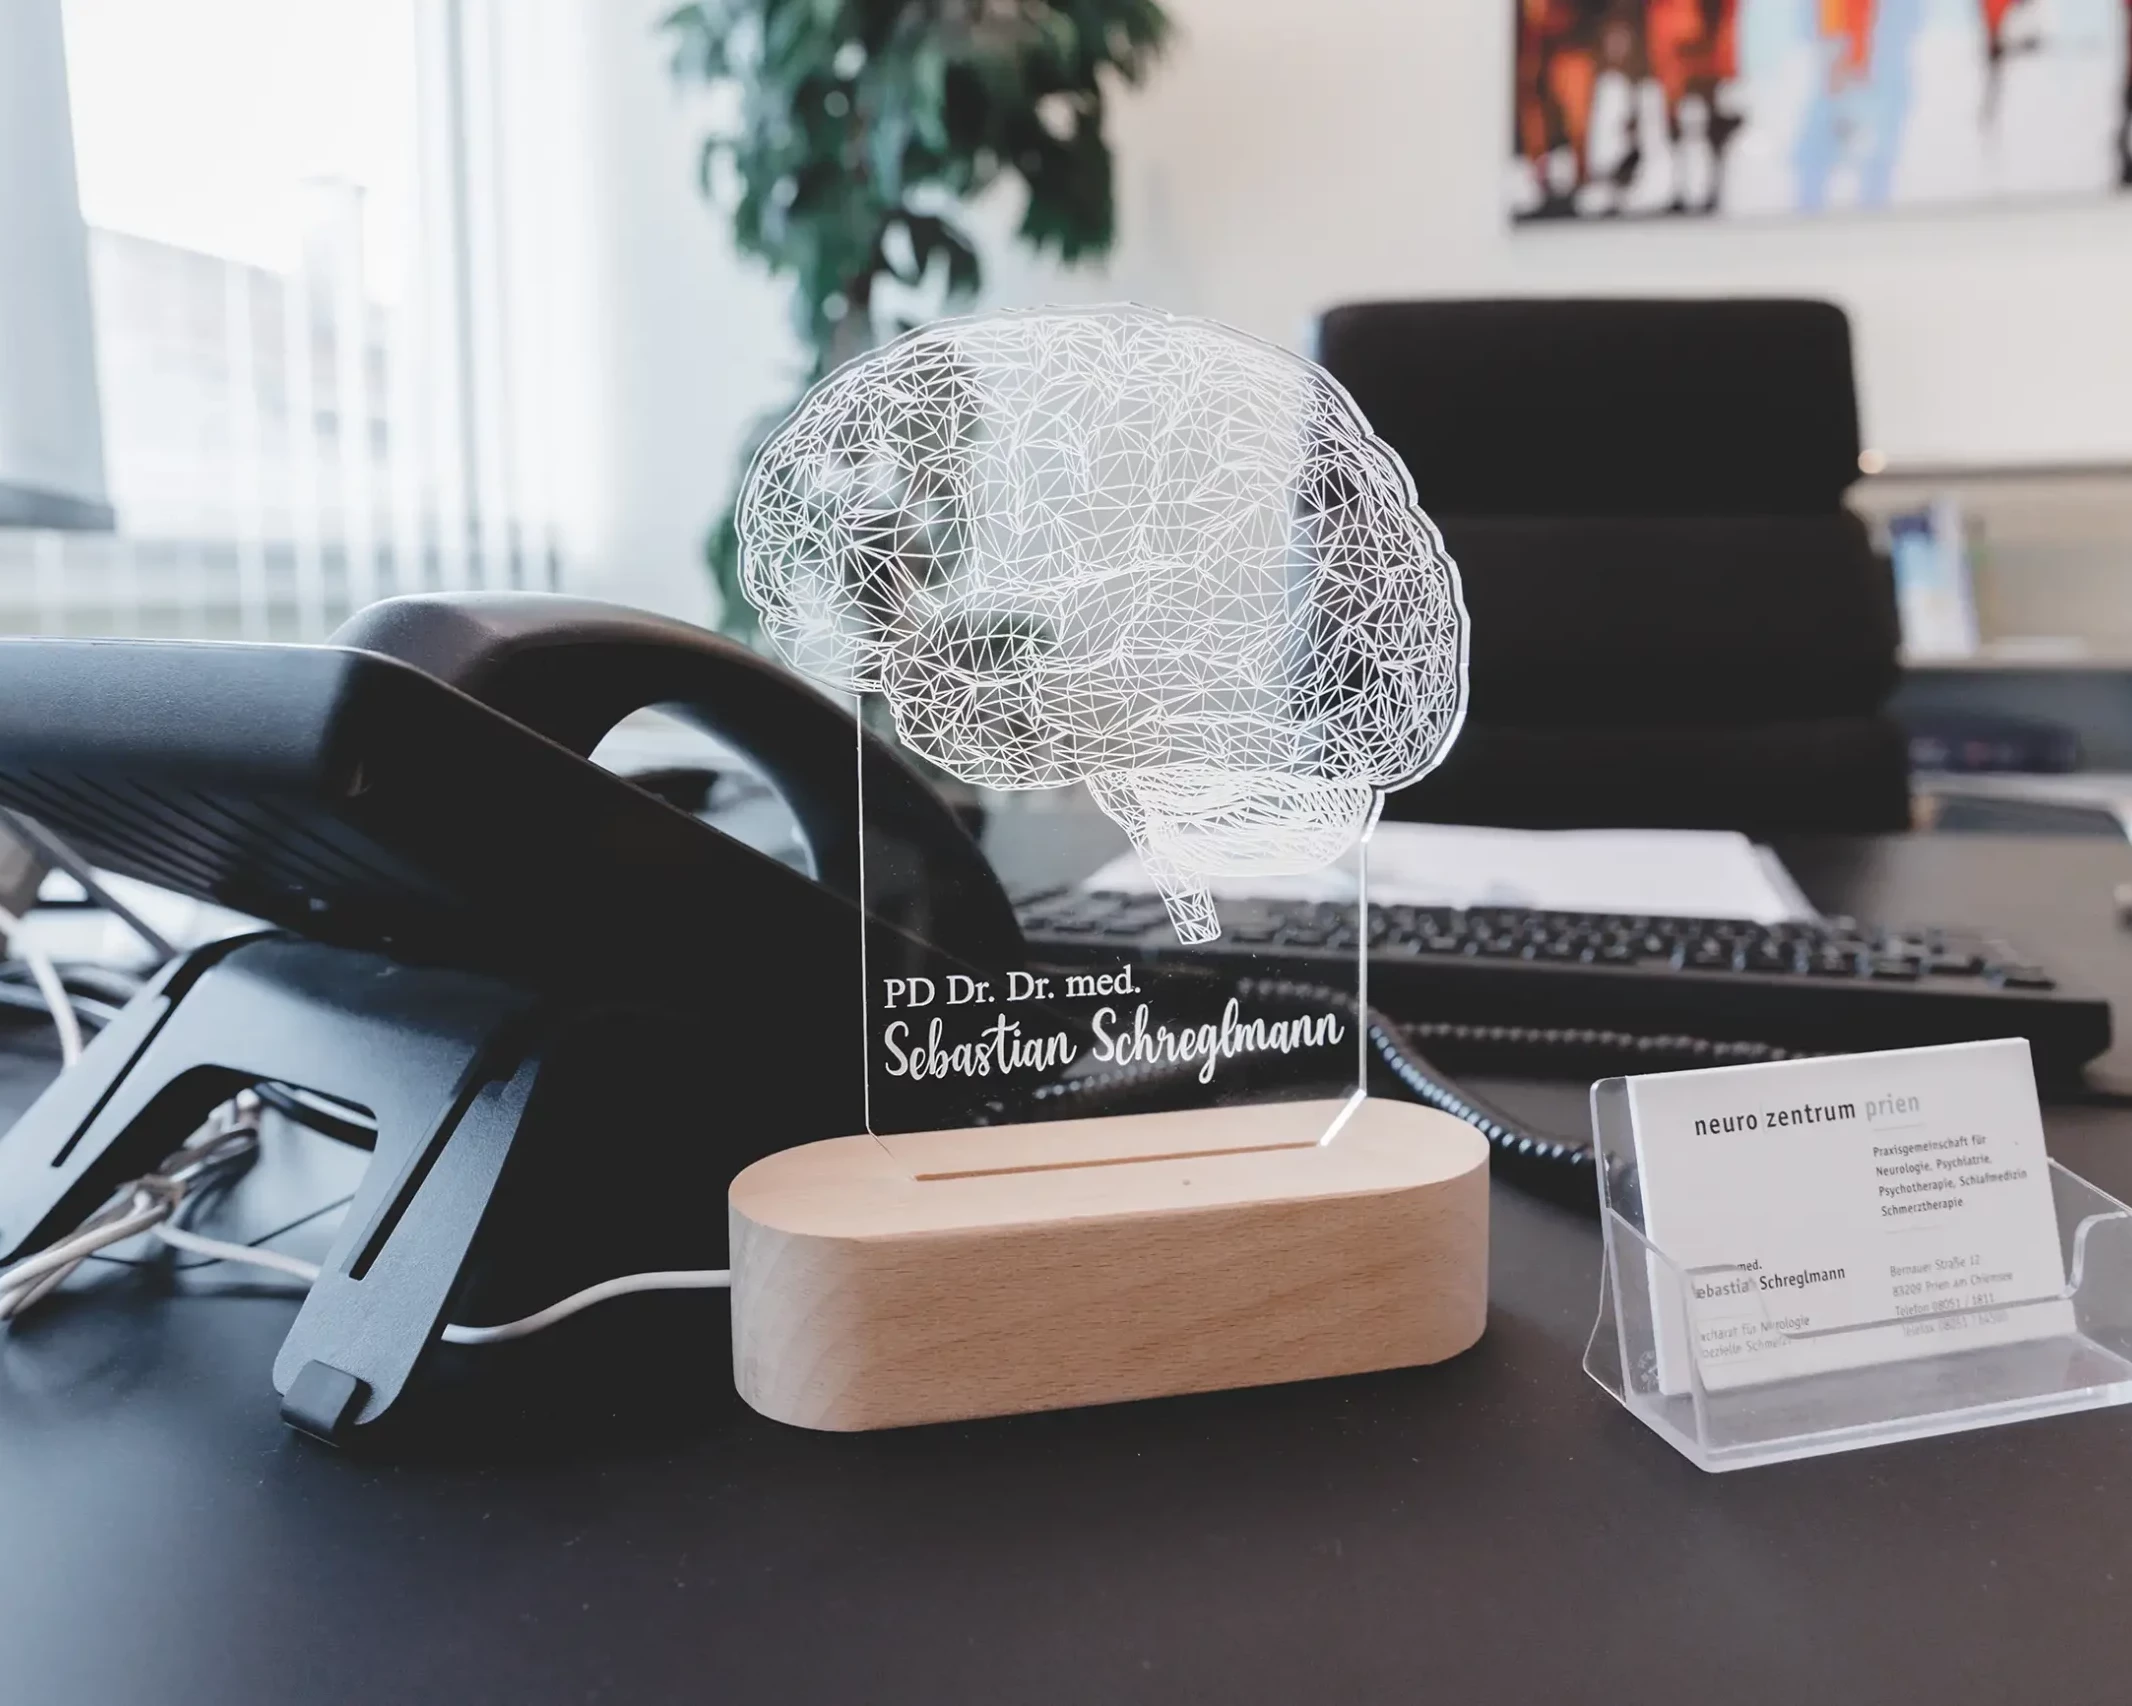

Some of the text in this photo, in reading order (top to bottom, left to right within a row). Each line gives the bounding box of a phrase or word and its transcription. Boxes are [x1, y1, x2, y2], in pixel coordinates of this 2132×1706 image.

[884, 964, 1141, 1009] PD Dr. Dr. med.
[884, 997, 1346, 1084] Sebastian Schreglmann
[1694, 1092, 1920, 1136] neuro zentrum prien
[1872, 1134, 1987, 1157] Praxisgemeinschaft für
[1876, 1154, 1992, 1177] Neurologie, Psychiatrie,
[1878, 1168, 2028, 1198] Psychotherapie, Schlafmedizin
[1881, 1197, 1964, 1217] Schmerztherapie
[1890, 1263, 1932, 1278] Bernauer
[1935, 1255, 1966, 1271] Straße
[1759, 1267, 1846, 1291] Schreglmann
[1926, 1279, 1950, 1292] Prien
[1895, 1300, 1930, 1317] Telefon
